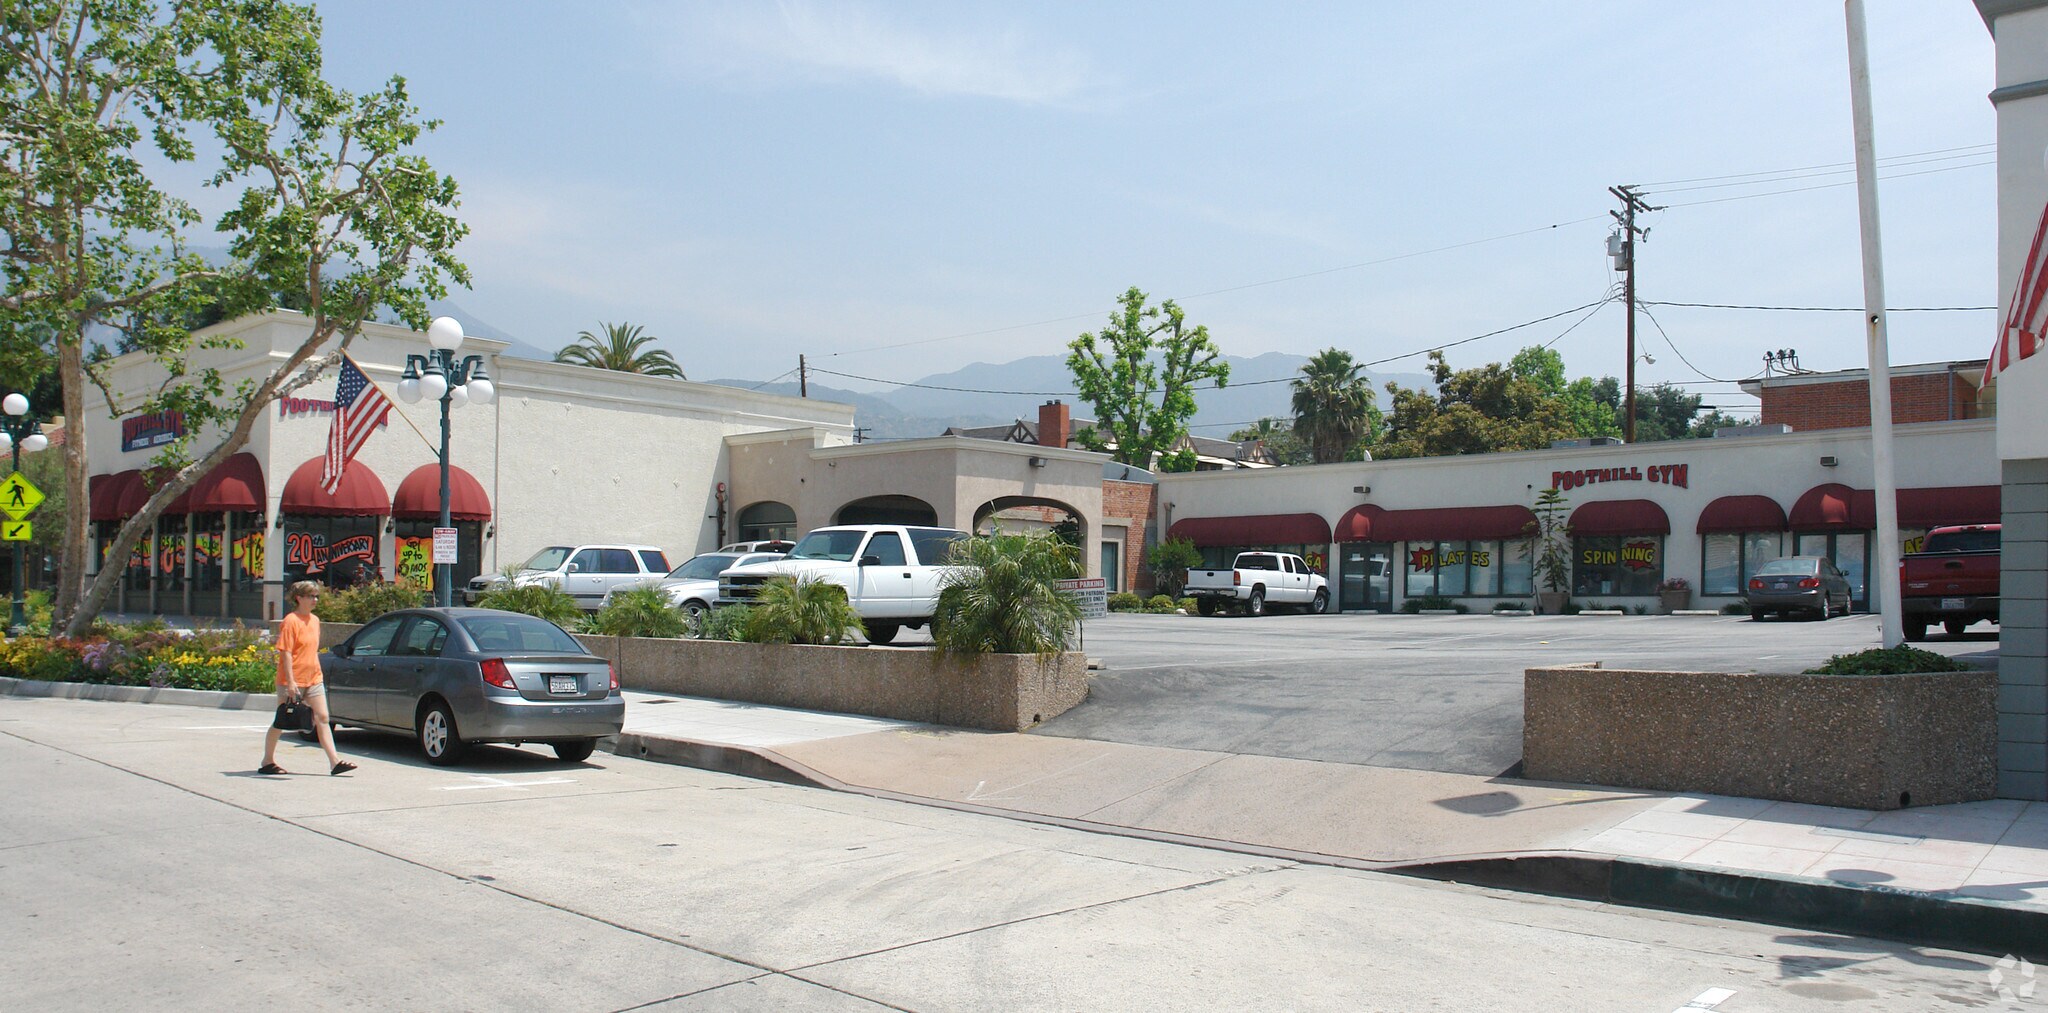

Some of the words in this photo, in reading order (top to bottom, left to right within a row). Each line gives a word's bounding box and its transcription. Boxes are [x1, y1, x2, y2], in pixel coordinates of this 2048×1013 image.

[1552, 467, 1643, 491] FOOTHILL
[1647, 464, 1688, 489] GYM
[316, 537, 369, 563] ANNIVERSARY
[1583, 547, 1655, 564] SPINNING
[1305, 554, 1322, 570] GA
[1421, 551, 1490, 567] PILATES
[1080, 580, 1104, 588] PARKING
